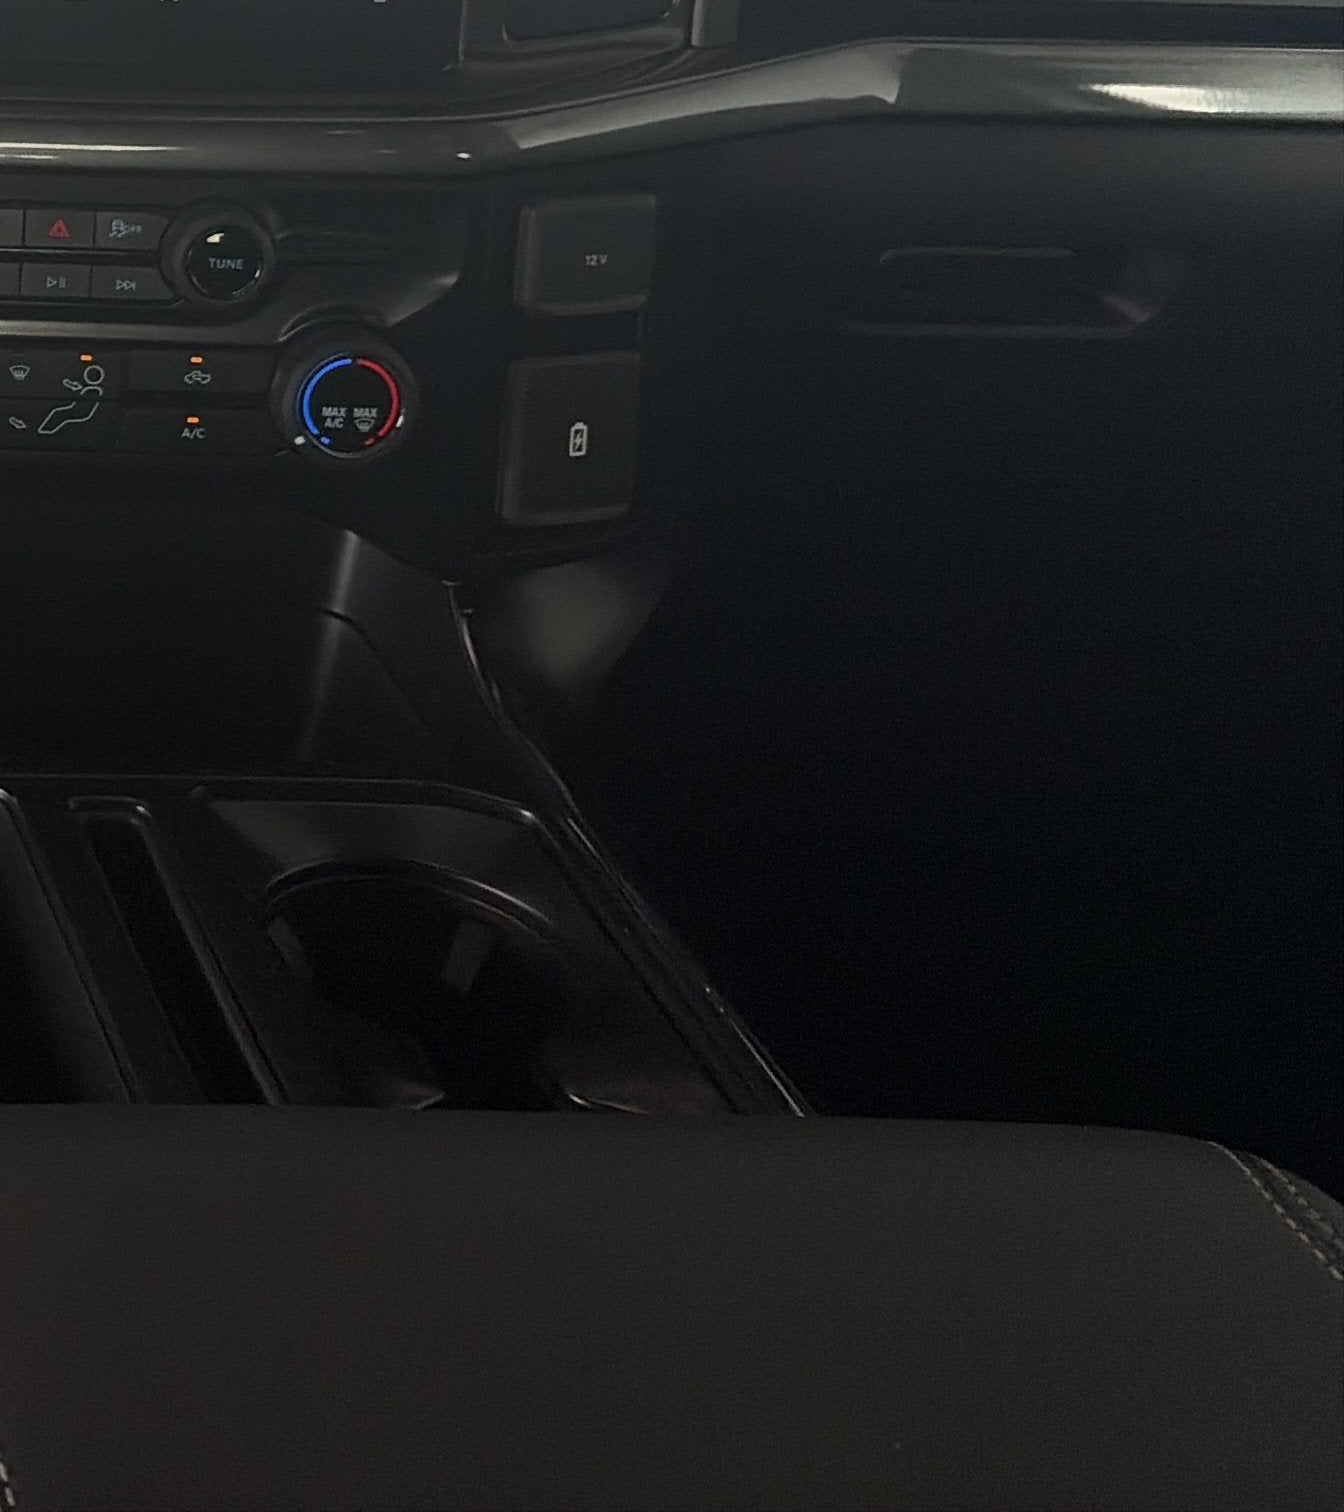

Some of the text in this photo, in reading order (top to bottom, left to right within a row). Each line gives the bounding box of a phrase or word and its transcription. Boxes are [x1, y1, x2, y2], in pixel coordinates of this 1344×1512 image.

[208, 258, 245, 270] TUNE
[322, 406, 347, 418] MAX
[353, 407, 378, 418] MAX
[324, 417, 344, 429] A/C
[181, 427, 206, 439] A/C
